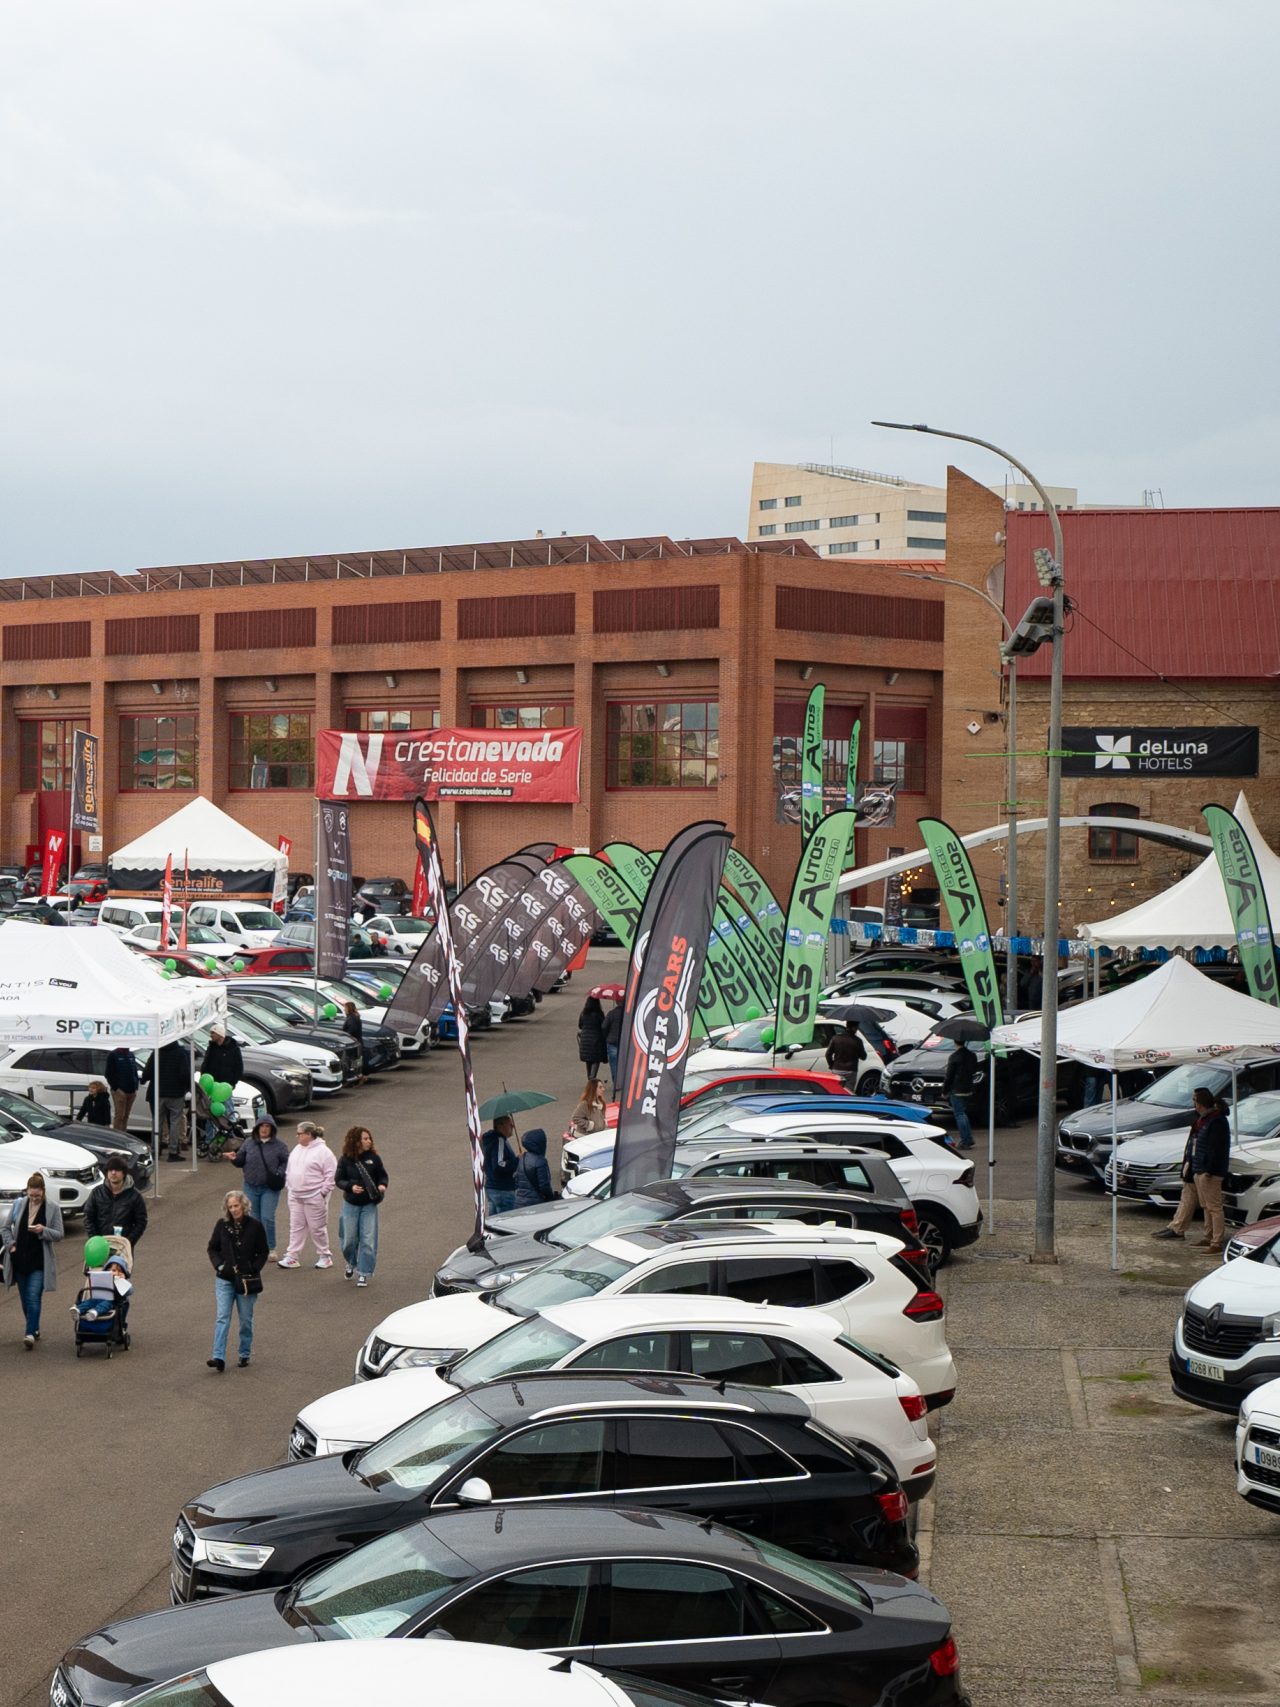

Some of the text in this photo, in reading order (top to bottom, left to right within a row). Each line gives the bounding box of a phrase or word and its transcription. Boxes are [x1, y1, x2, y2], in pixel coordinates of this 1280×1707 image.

[395, 733, 563, 762] crestanevada
[1139, 739, 1208, 755] deLuna
[1138, 757, 1192, 770] HOTELS
[424, 767, 532, 784] Felicidad de Serie
[799, 836, 831, 921] AUTOS
[1191, 1361, 1222, 1379] 0268 KTL
